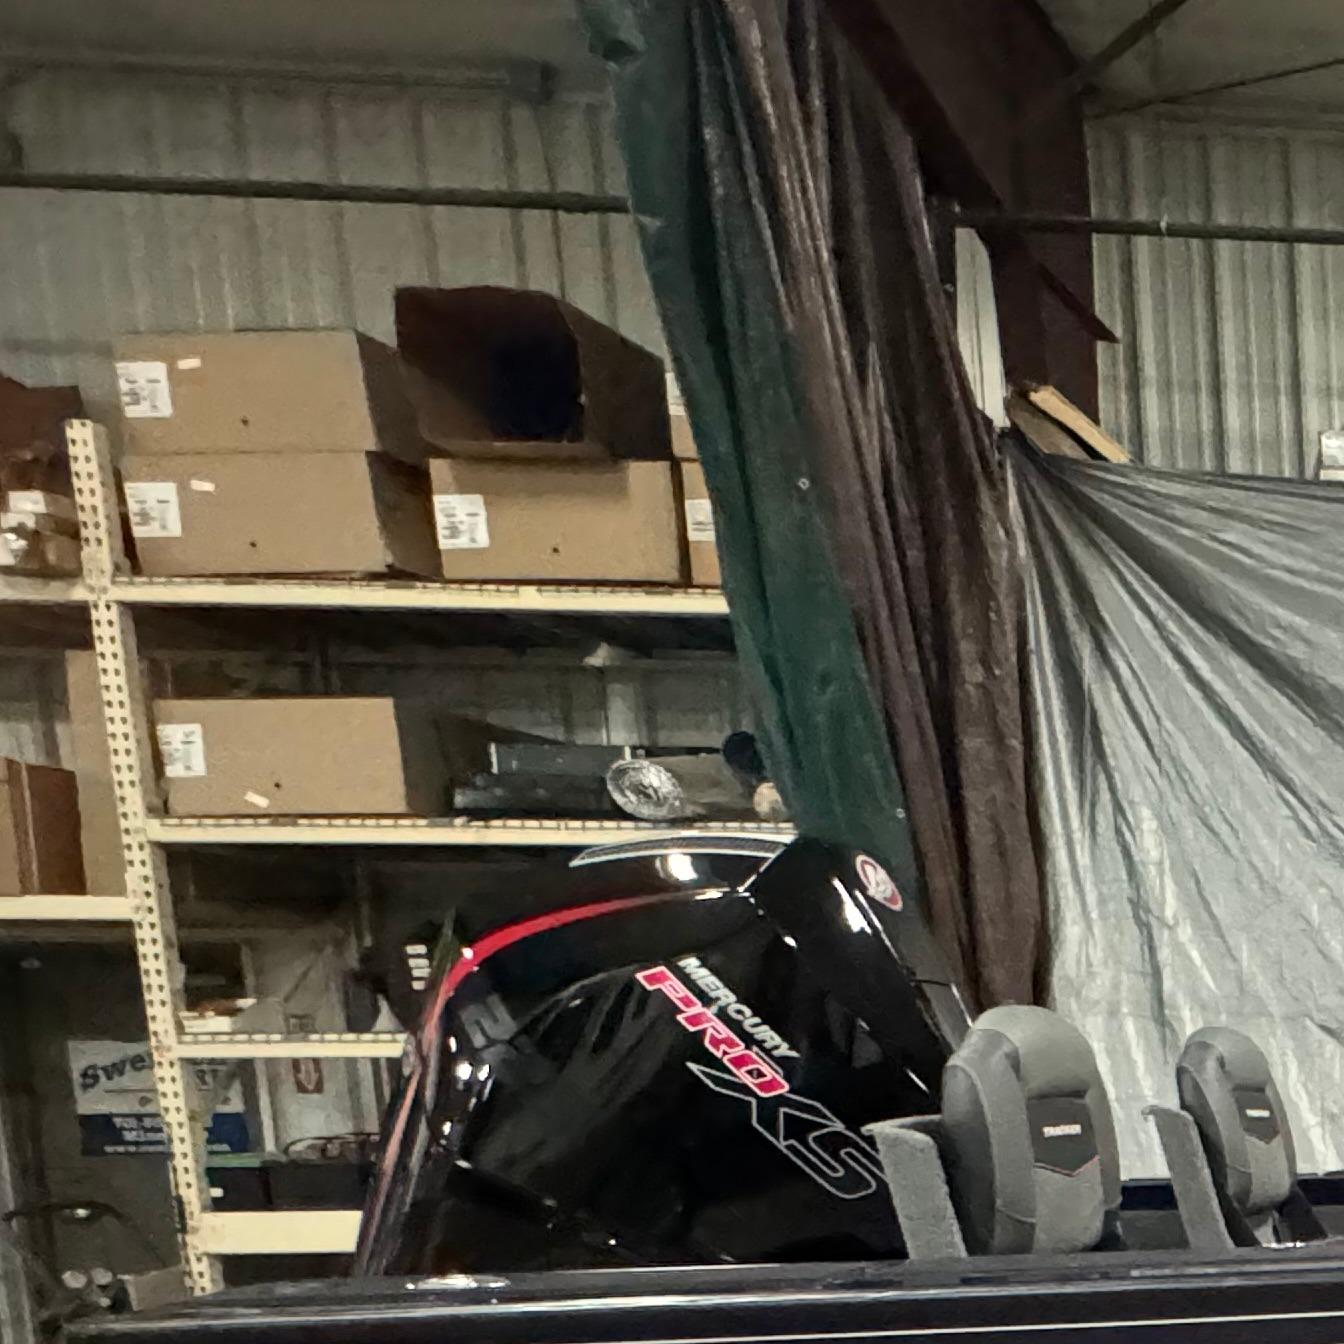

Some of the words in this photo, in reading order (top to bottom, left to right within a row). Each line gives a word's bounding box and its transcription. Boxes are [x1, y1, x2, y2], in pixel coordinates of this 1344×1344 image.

[635, 965, 790, 1098] PRO
[677, 956, 800, 1058] MERCURY
[79, 1051, 154, 1094] Swe
[685, 1062, 888, 1200] XS
